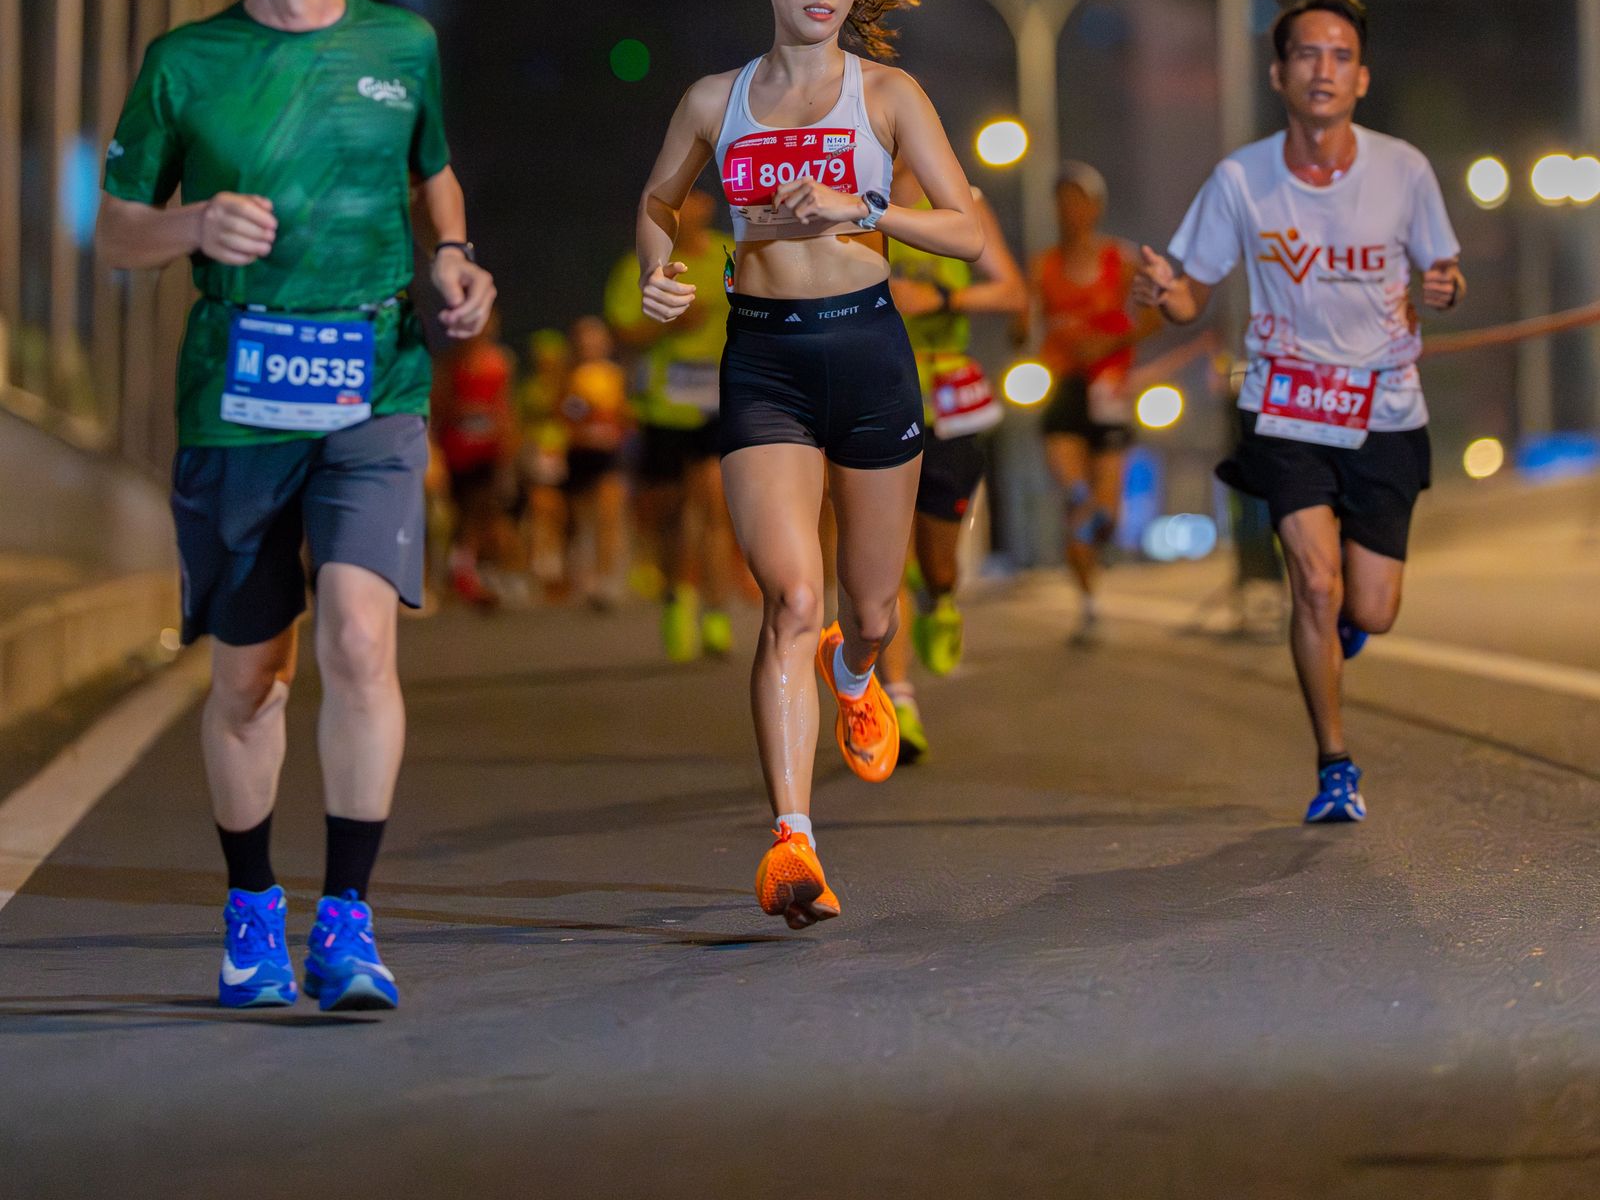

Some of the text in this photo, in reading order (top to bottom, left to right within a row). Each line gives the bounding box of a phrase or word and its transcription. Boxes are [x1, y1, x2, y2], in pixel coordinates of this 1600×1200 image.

[737, 163, 747, 187] F
[760, 158, 846, 188] 80479
[738, 307, 771, 319] TECHFIT
[818, 305, 860, 320] TECHFIT
[238, 347, 260, 376] M
[266, 354, 365, 388] 90535
[1296, 384, 1367, 416] 81637
